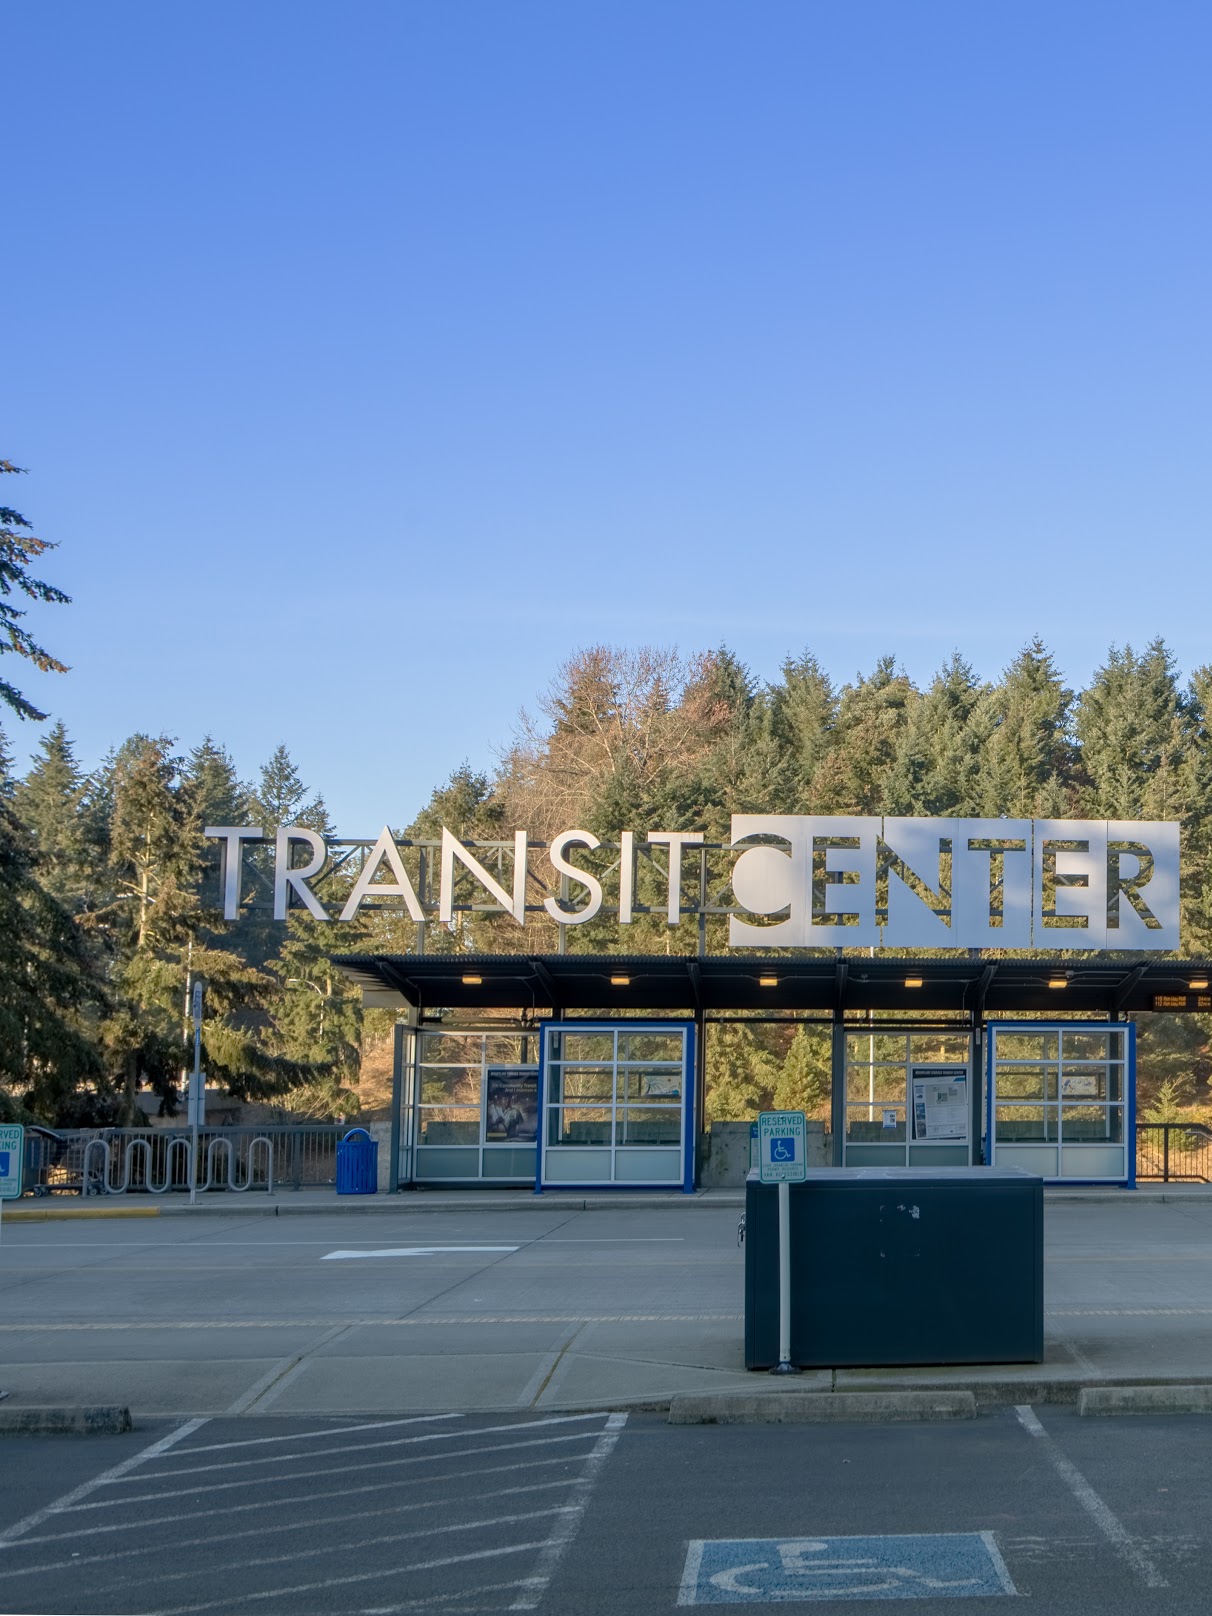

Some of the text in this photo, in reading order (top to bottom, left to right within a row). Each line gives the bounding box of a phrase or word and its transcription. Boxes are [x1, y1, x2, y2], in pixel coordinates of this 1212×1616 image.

[205, 825, 704, 926] TRANSIT
[731, 833, 1164, 930] CENTER
[762, 1116, 802, 1126] RESERVED
[764, 1127, 801, 1137] PARKING
[0, 1141, 17, 1150] ING
